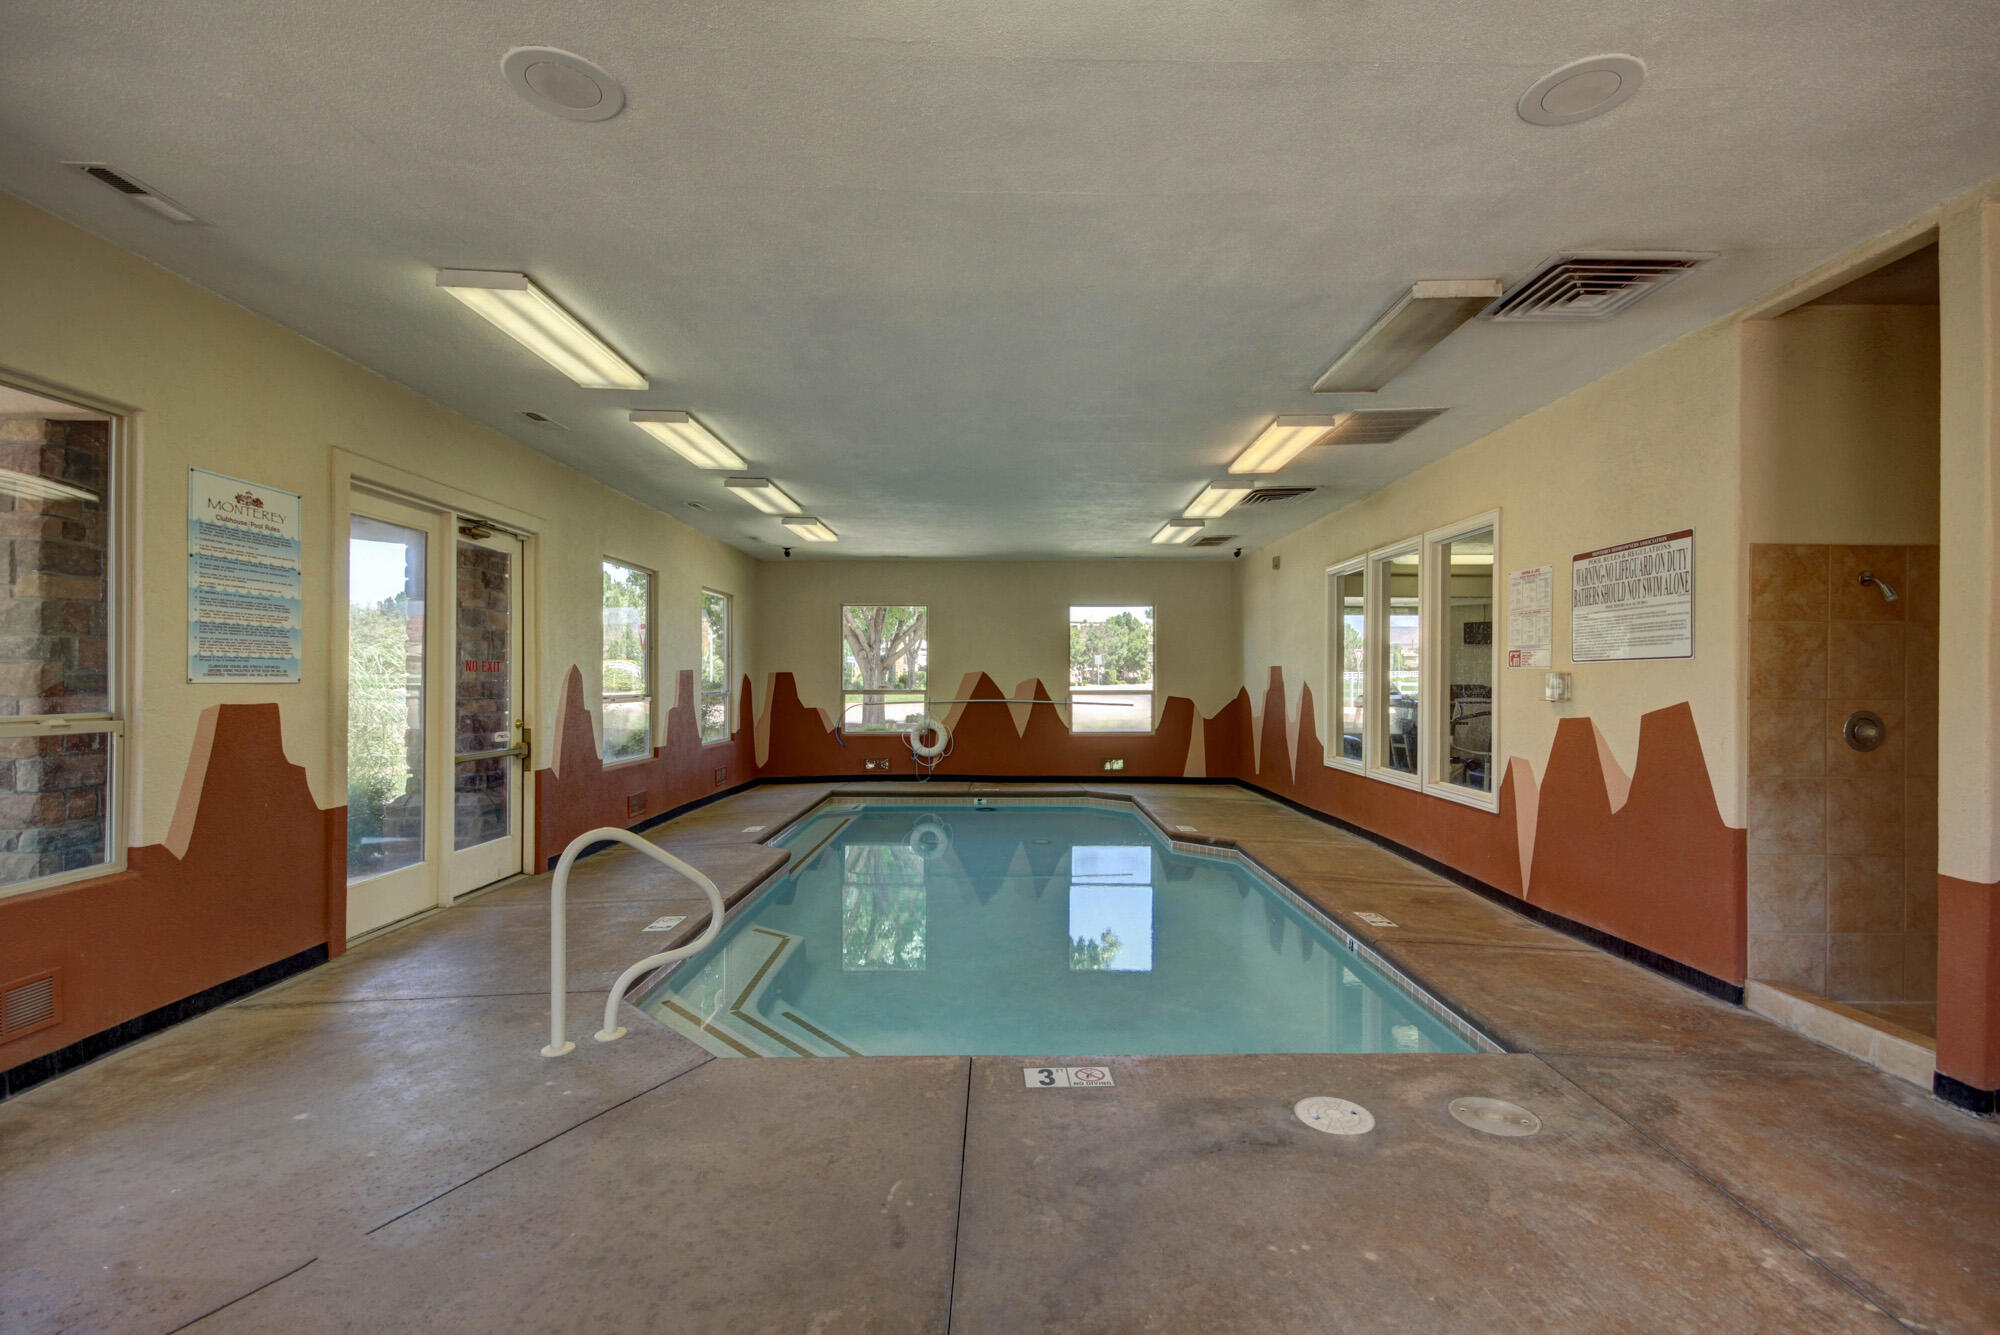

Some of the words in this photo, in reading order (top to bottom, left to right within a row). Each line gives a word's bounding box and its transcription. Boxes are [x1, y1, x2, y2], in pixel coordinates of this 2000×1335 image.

[207, 497, 288, 525] MONTEREY
[264, 524, 281, 534] Rules
[1588, 557, 1602, 566] POOL
[1602, 554, 1621, 563] RULES
[1627, 543, 1672, 558] REGULATIONS
[1615, 554, 1654, 581] LIFEGUARD
[1654, 550, 1667, 574] ON
[1667, 547, 1689, 571] DUTY
[1573, 586, 1600, 608] BATHERS
[1600, 581, 1626, 605] SHOULD
[1626, 578, 1641, 600] NOT
[1642, 574, 1663, 599] SWIM
[1663, 571, 1690, 596] ALONE
[464, 660, 479, 672] NO
[481, 660, 502, 673] EXIT
[1038, 1069, 1056, 1086] 3
